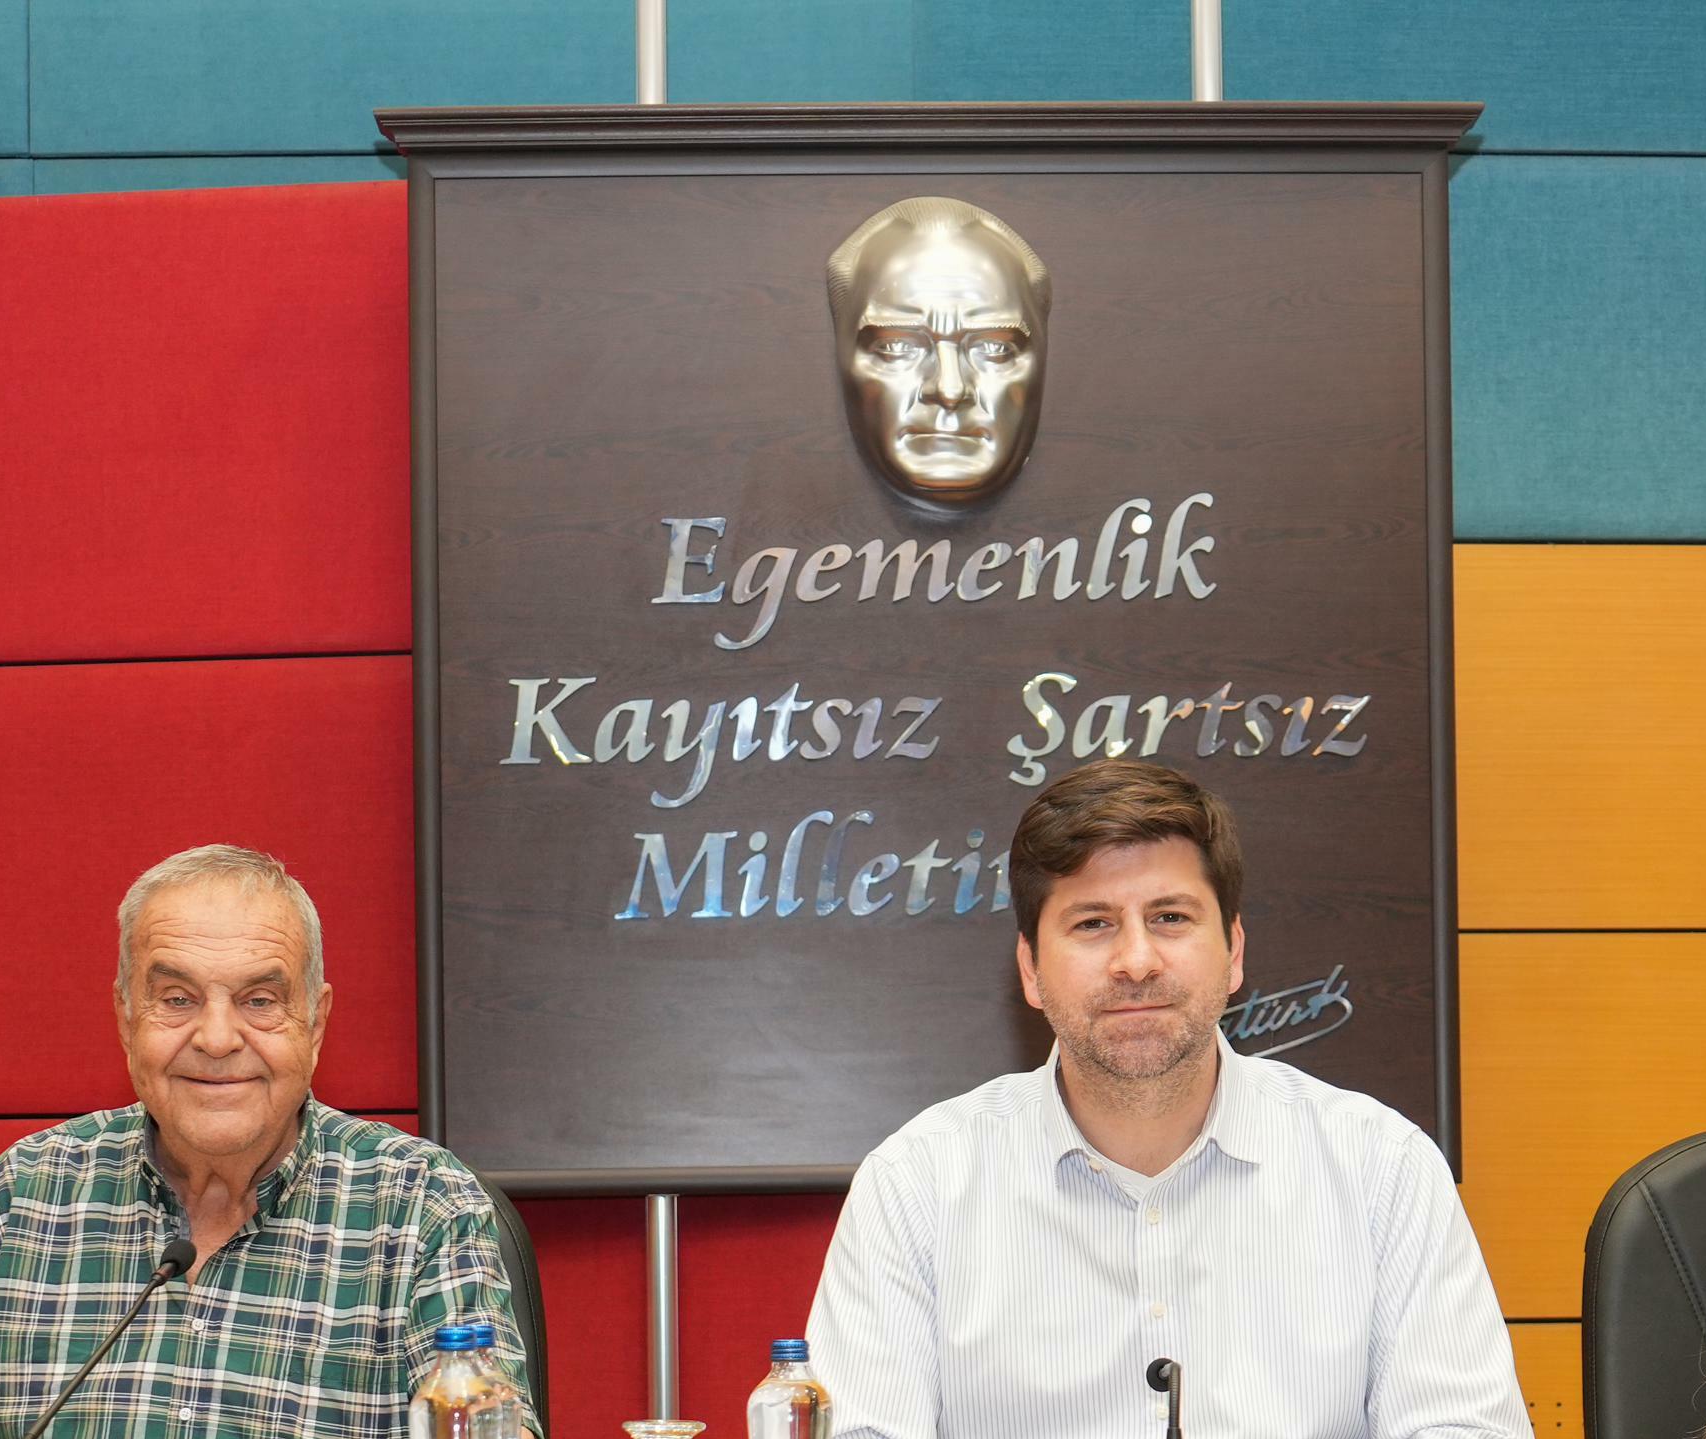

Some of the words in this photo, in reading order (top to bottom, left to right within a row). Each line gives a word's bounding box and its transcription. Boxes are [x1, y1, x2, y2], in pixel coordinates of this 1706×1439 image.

[651, 493, 1218, 650] Egemenlik
[499, 676, 943, 808] Kayıtsız
[1006, 671, 1372, 786] Şartsız
